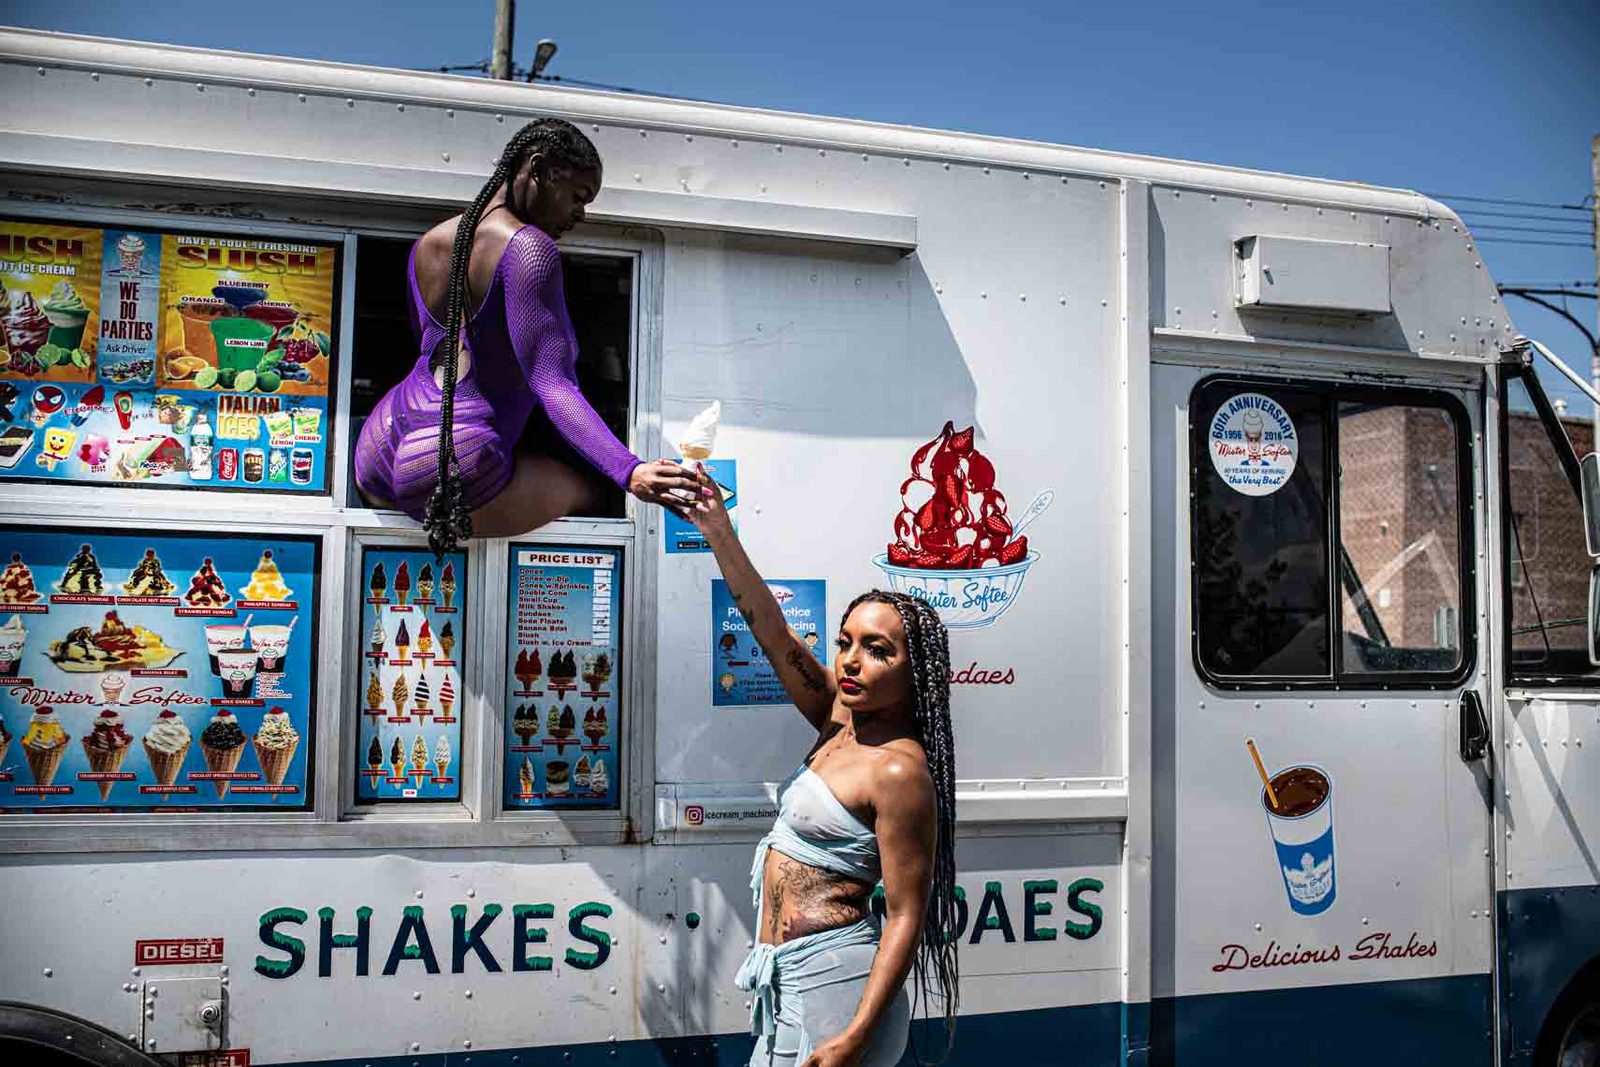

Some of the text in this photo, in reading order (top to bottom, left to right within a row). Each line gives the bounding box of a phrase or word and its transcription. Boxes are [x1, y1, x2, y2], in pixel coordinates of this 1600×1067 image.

[177, 236, 205, 246] HAVE
[209, 238, 216, 246] A
[219, 239, 248, 248] COOL
[18, 262, 36, 273] ICE
[38, 264, 76, 276] CREAM
[177, 246, 318, 277] SLUSH
[119, 281, 140, 301] WE
[218, 280, 270, 289] BLUEBERRY
[181, 296, 224, 304] ORANGE
[120, 301, 137, 320] DO
[101, 320, 153, 341] PARTIES
[105, 344, 146, 354] Ask Driver
[226, 339, 249, 347] LEMON
[219, 394, 281, 415] ITALIAN
[218, 415, 259, 438] ICES
[1213, 396, 1294, 440] 60th ANNIVERSARY
[1224, 430, 1242, 440] 1956
[1214, 440, 1246, 457] Mister
[1243, 475, 1260, 487] Very
[530, 554, 603, 565] PRICE LIST
[909, 581, 1009, 613] Mister Softee
[751, 647, 759, 657] 6
[949, 661, 1015, 685] daes
[10, 686, 207, 707] Mister Softee
[705, 808, 781, 821] icecream_machineN
[870, 877, 1105, 945] DAES
[253, 900, 614, 980] SHAKES
[143, 943, 224, 960] DIESEL
[1212, 931, 1438, 973] Delicious Shakes
